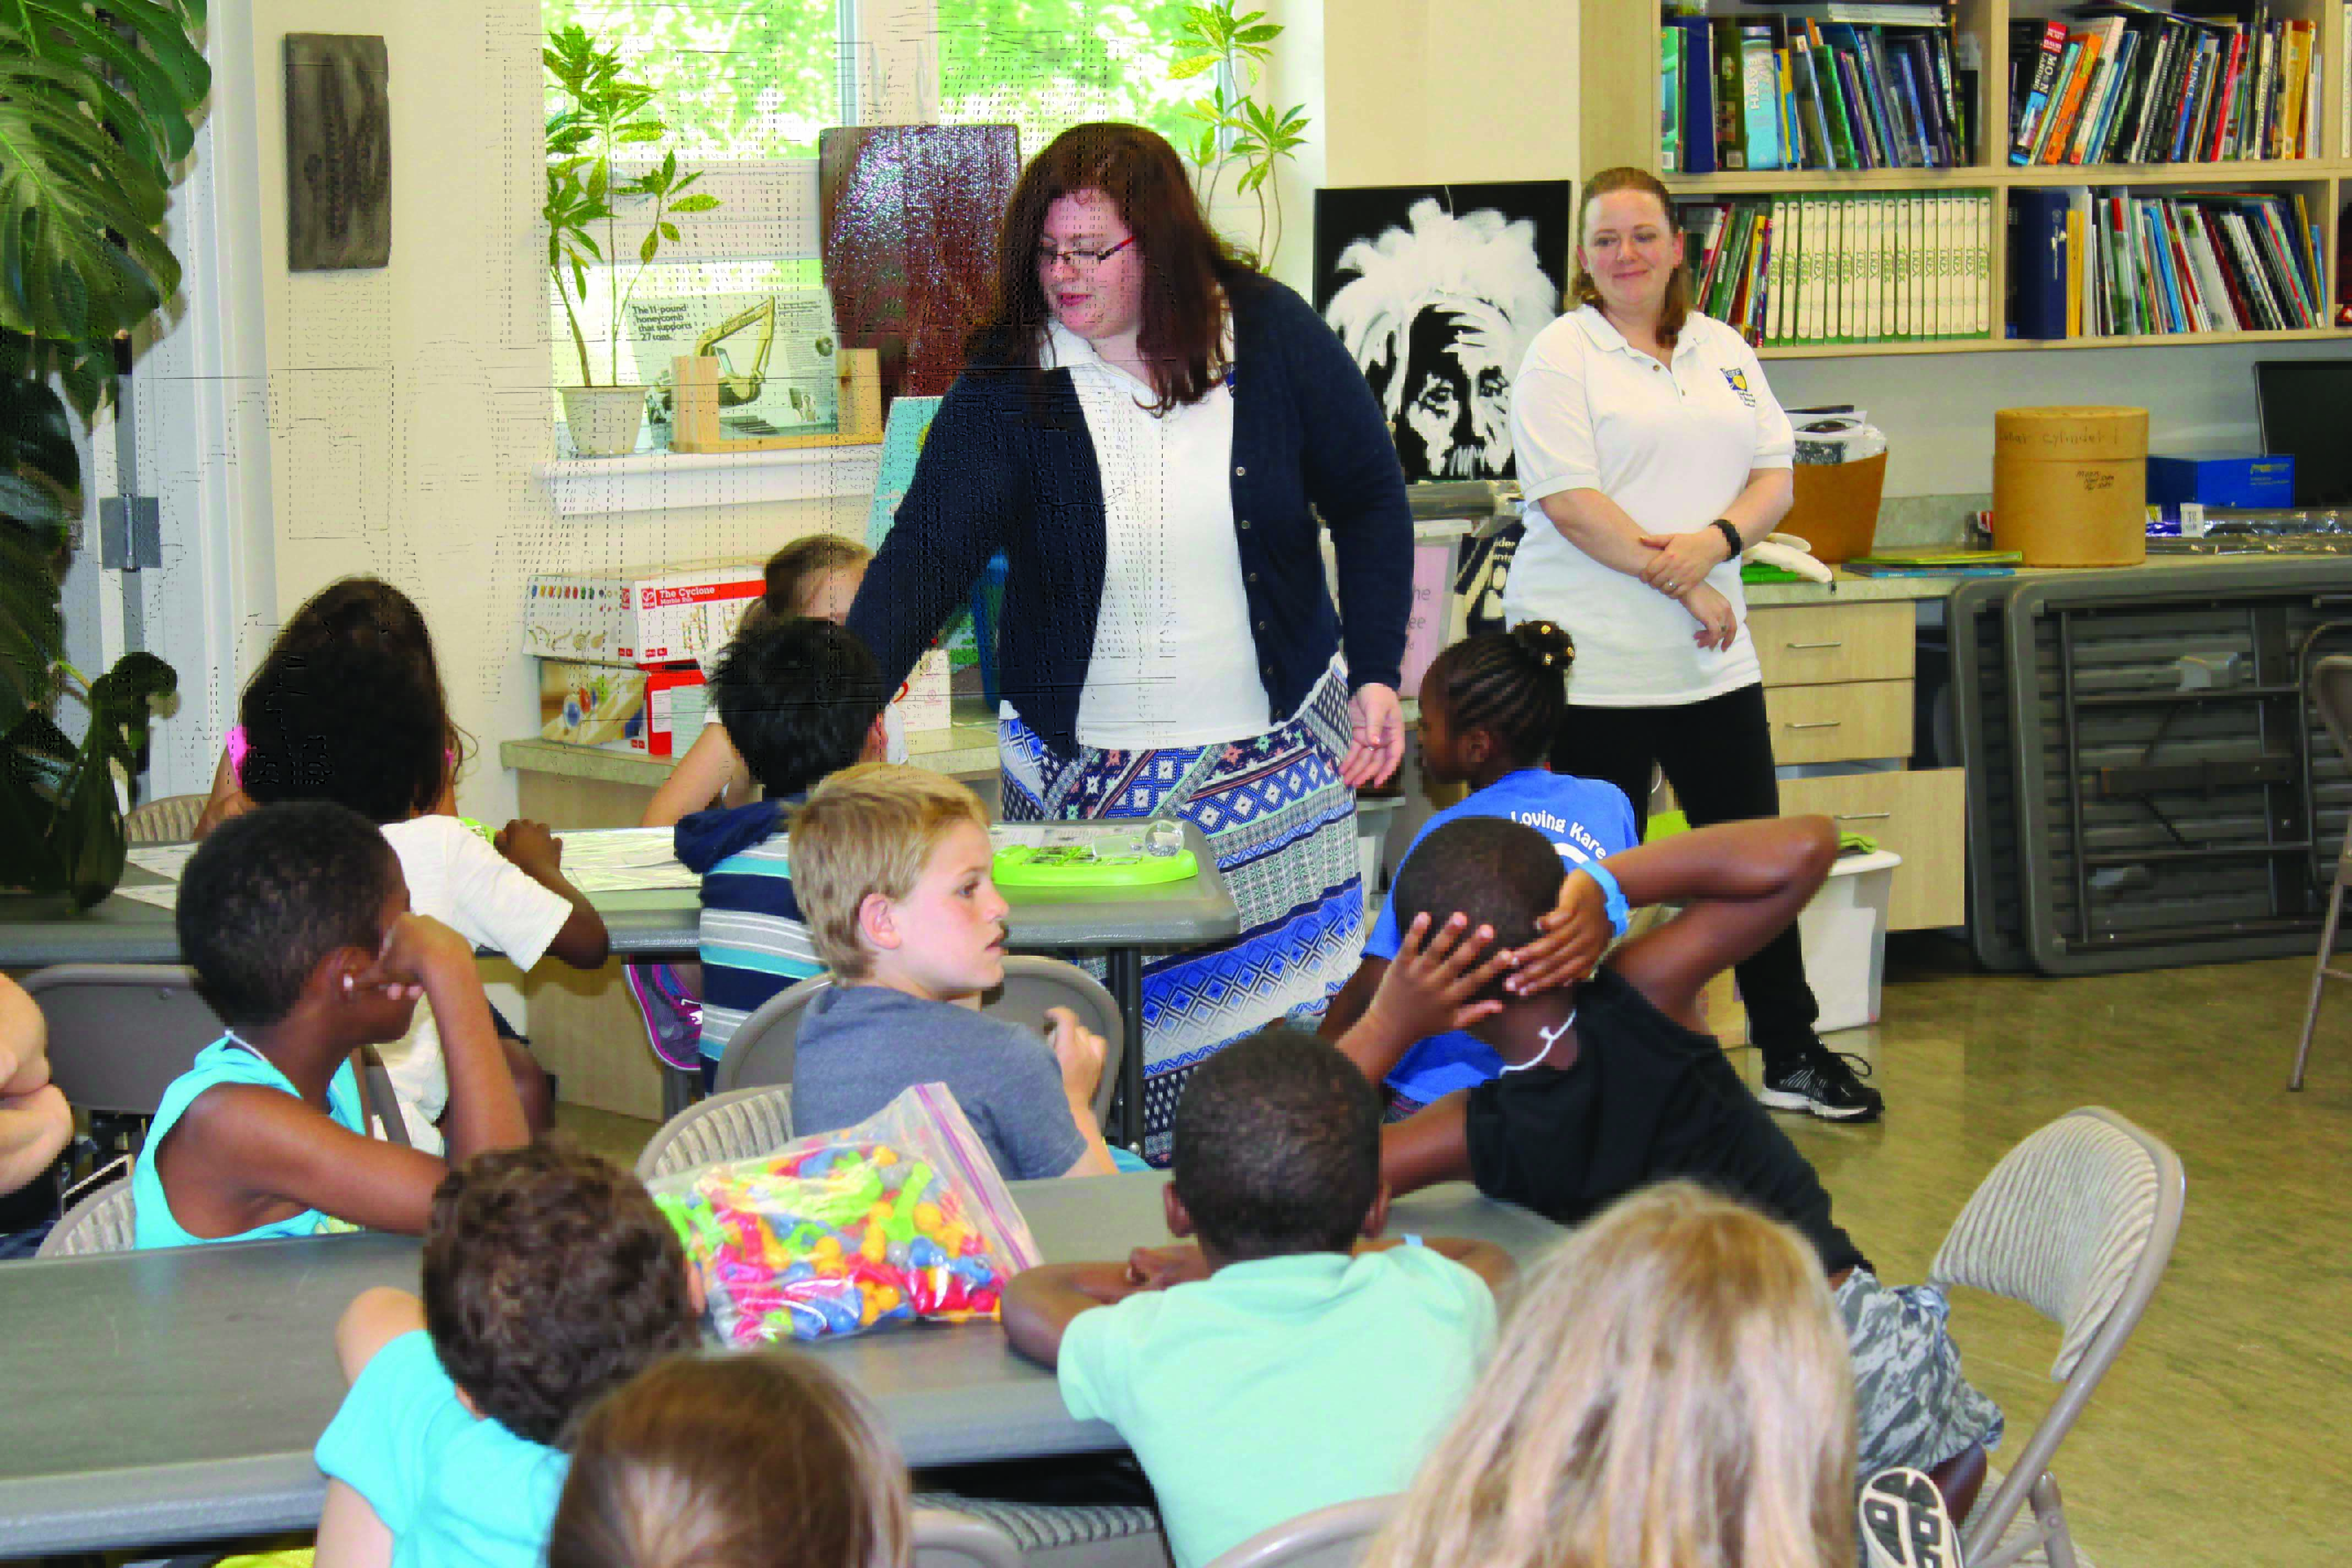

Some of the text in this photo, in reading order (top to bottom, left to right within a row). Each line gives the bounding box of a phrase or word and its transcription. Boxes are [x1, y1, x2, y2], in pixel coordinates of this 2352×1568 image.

[2033, 52, 2049, 90] LANDING
[632, 306, 649, 314] The
[635, 313, 684, 324] honeycomb
[638, 322, 693, 333] that supports
[640, 333, 651, 341] 27
[659, 586, 715, 598] The Cyclone
[1511, 810, 1607, 859] Loving Kare
